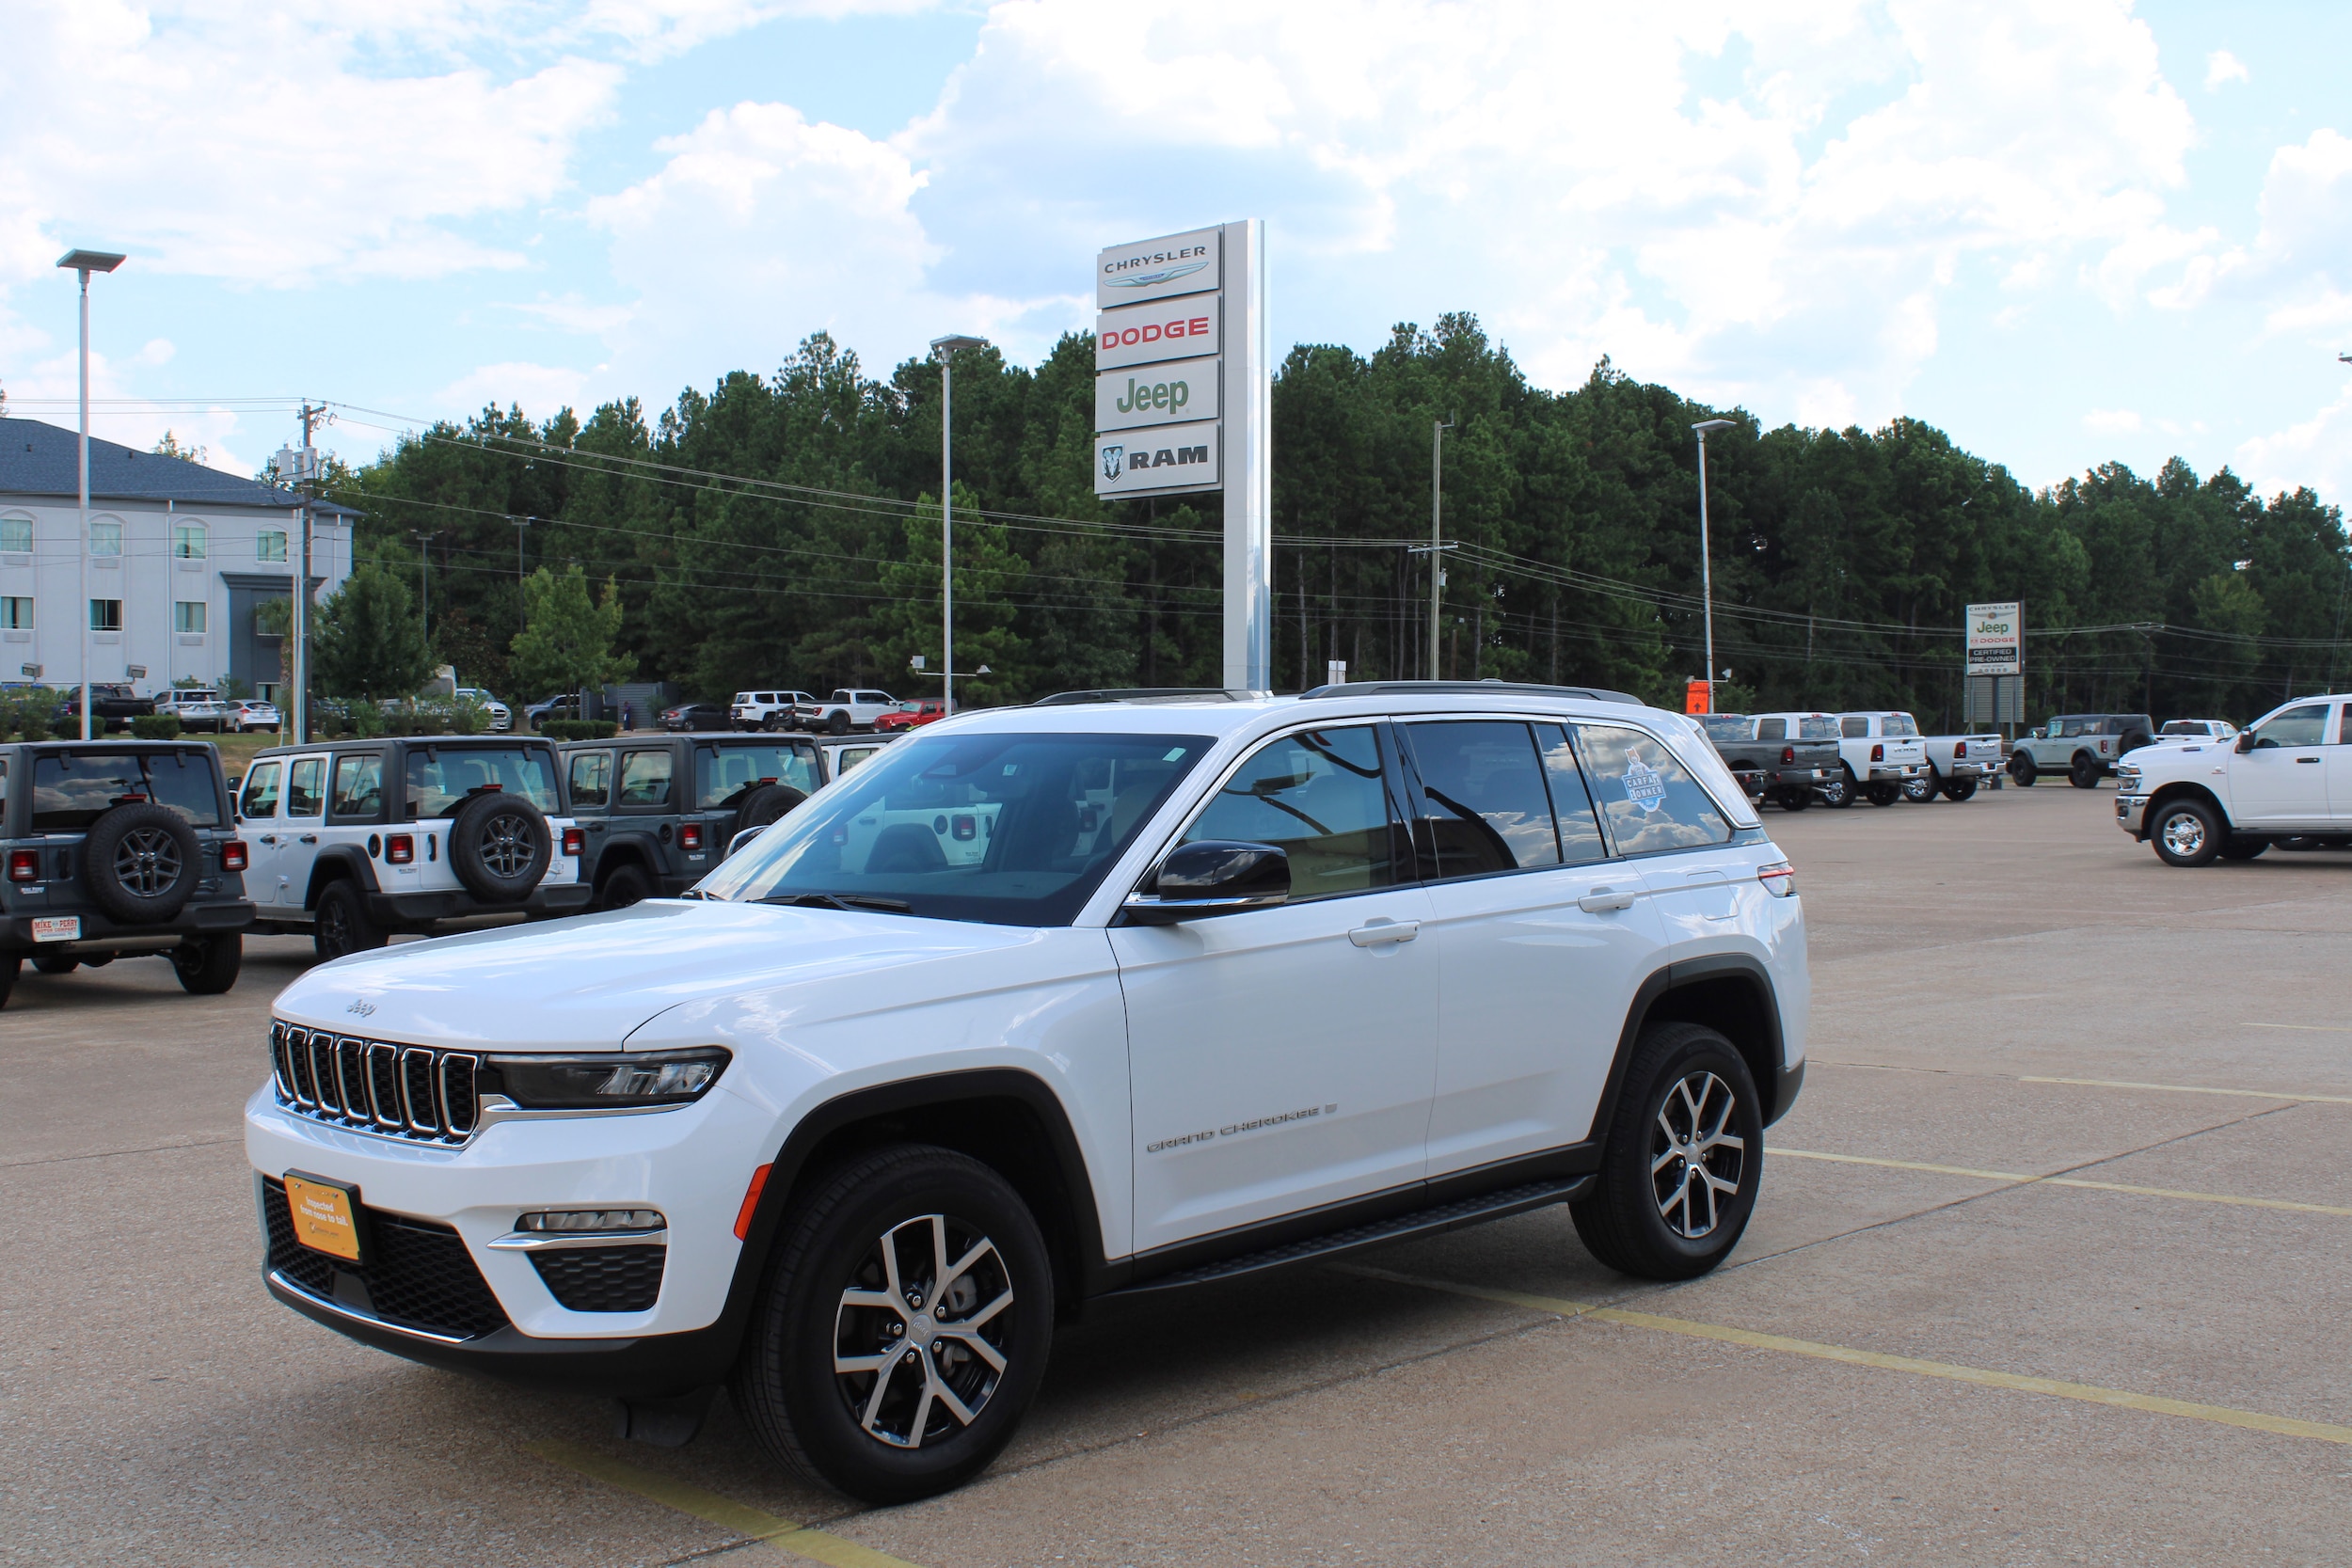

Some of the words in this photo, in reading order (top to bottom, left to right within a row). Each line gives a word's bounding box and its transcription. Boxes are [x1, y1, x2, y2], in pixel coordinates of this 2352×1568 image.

[1104, 245, 1206, 274] CHRYSLER
[1102, 316, 1209, 350] DODGE
[1116, 378, 1189, 415] Jeep
[1129, 445, 1208, 470] RAM
[1977, 621, 2009, 635] Jeep
[34, 919, 52, 929] MIKE
[59, 918, 77, 927] PERRY
[346, 998, 377, 1018] Jeep
[1147, 1130, 1216, 1152] GRAND
[1220, 1106, 1320, 1136] CHEROKEE
[327, 1213, 336, 1223] to
